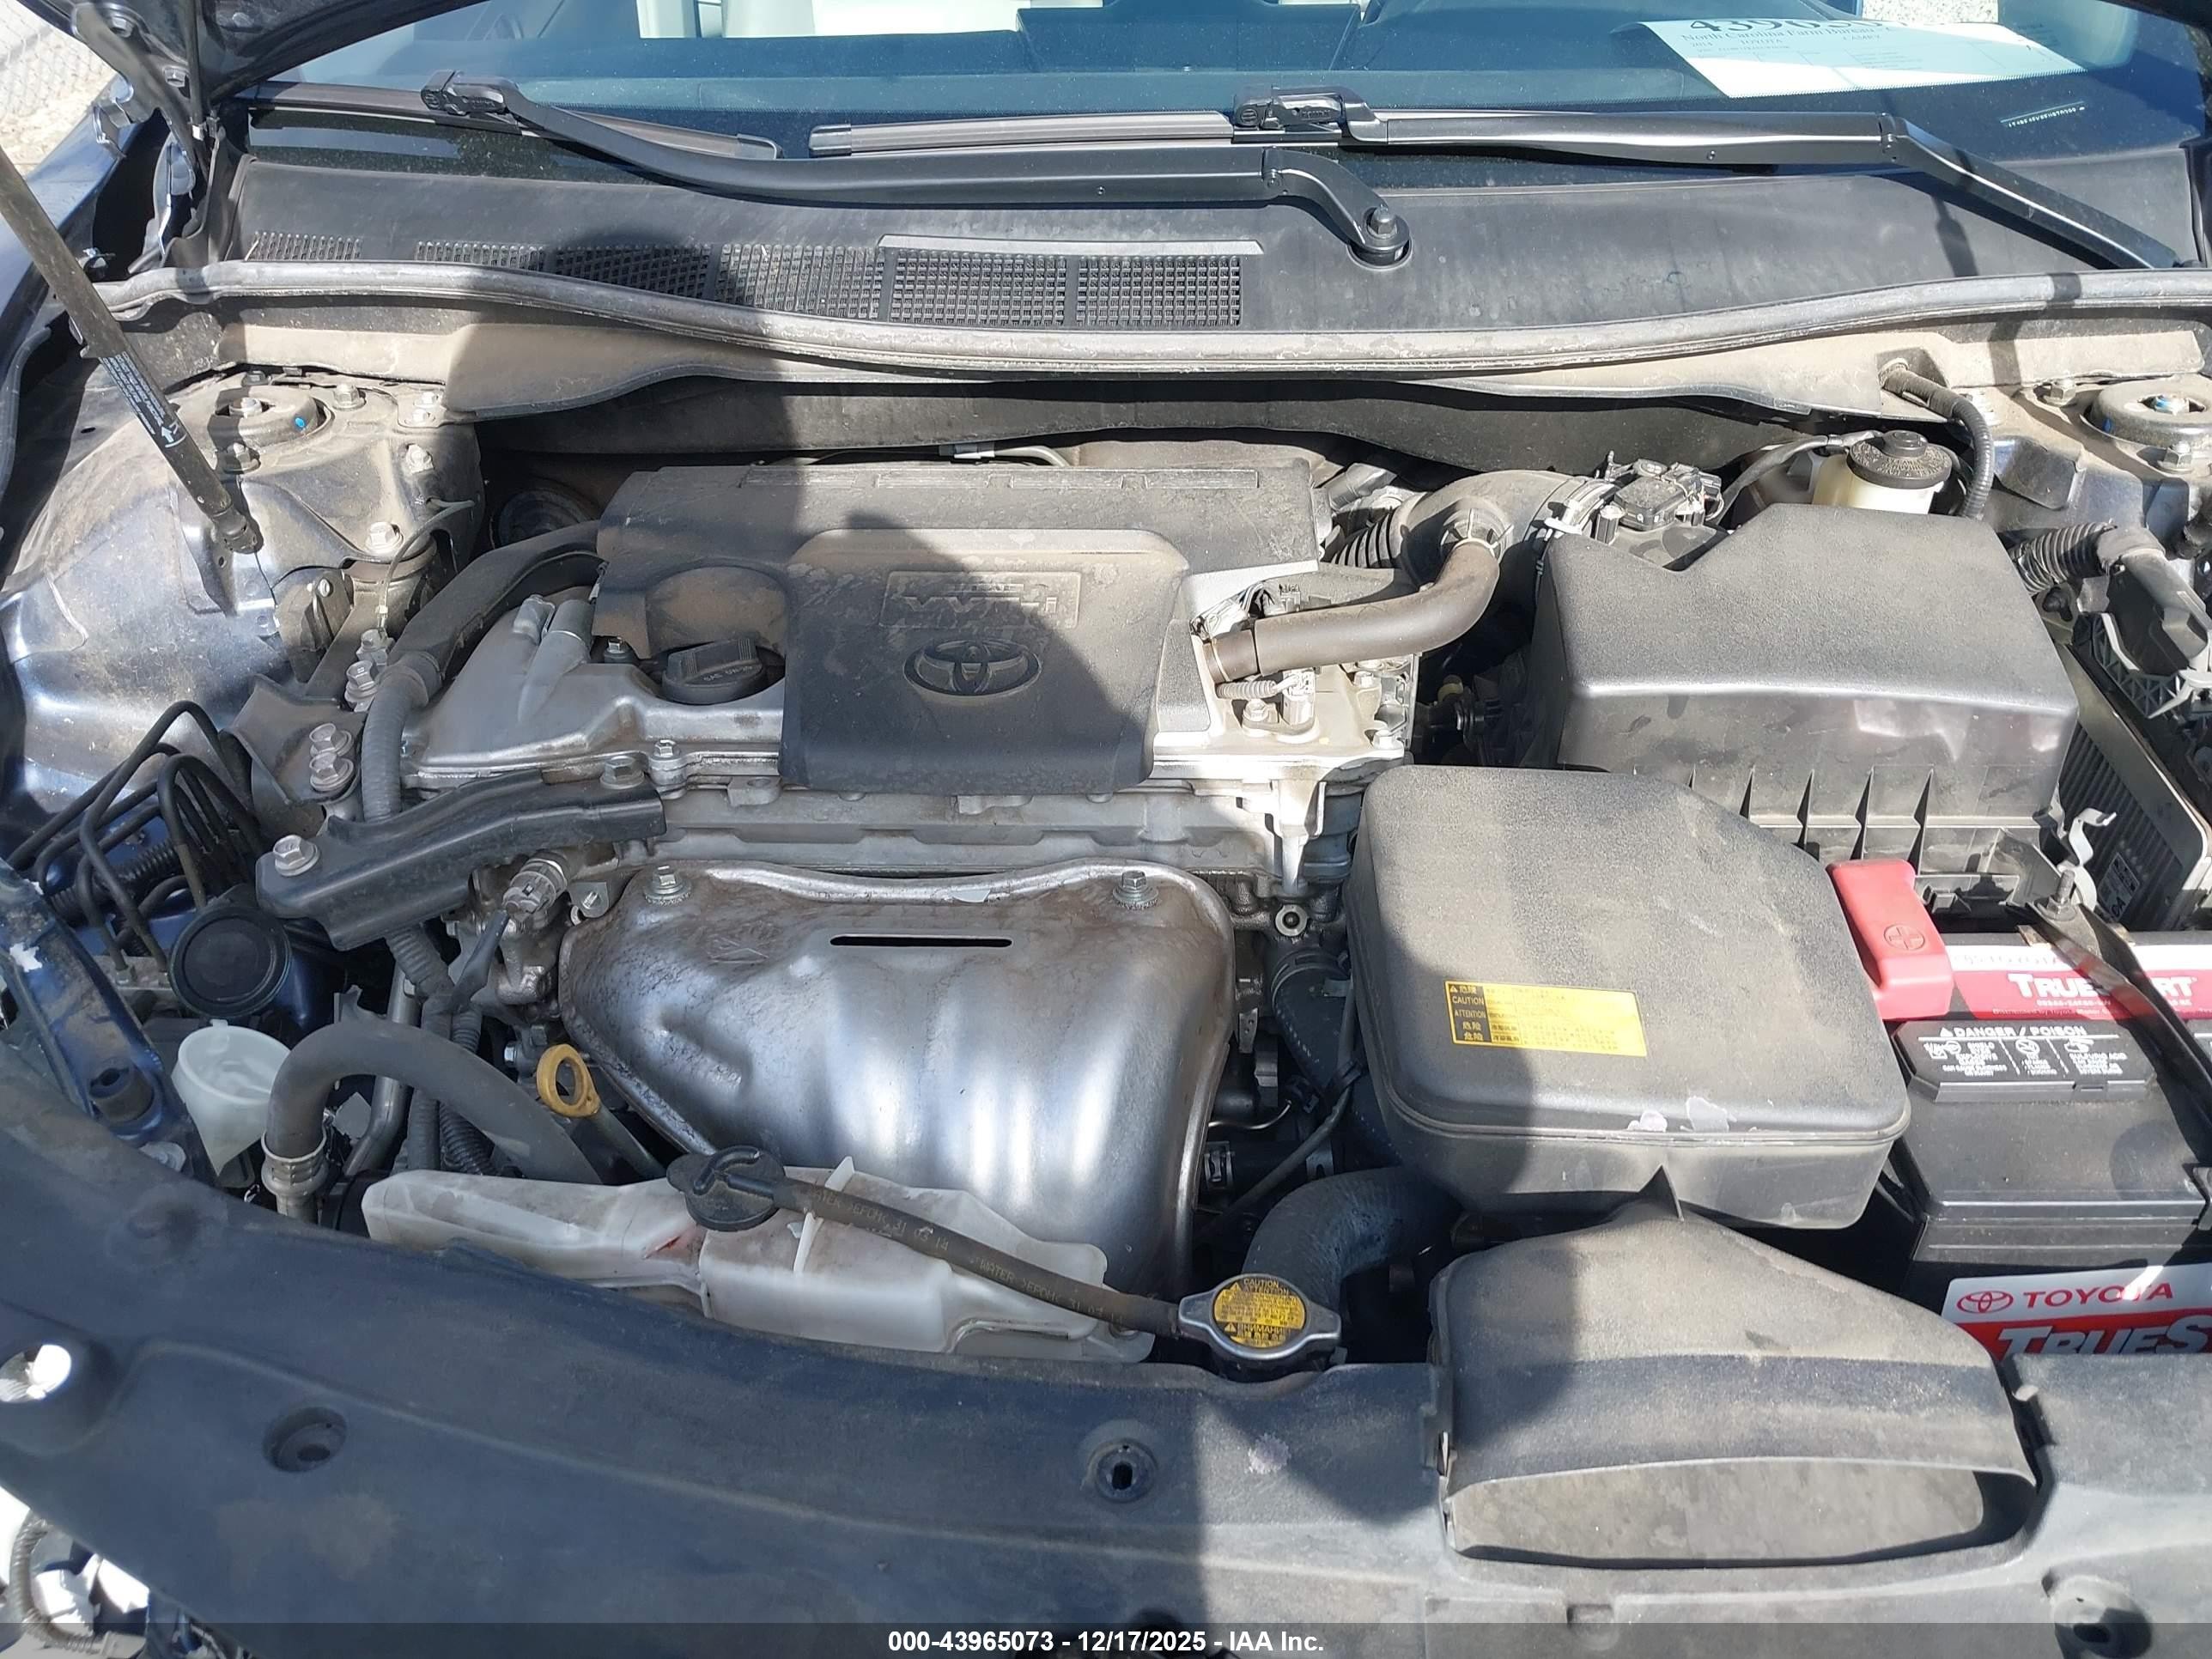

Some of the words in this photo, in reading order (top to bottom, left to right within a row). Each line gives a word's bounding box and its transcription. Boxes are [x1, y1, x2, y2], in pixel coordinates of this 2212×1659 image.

[1724, 30, 1785, 40] Carolina
[1452, 996, 1484, 1006] CAUTION
[1455, 1009, 1486, 1018] ATTENTION
[1954, 1026, 2017, 1037] DANGER
[2030, 1026, 2087, 1036] POISON
[1243, 1278, 1279, 1288] CAUTION
[2023, 1283, 2173, 1308] TOYOA
